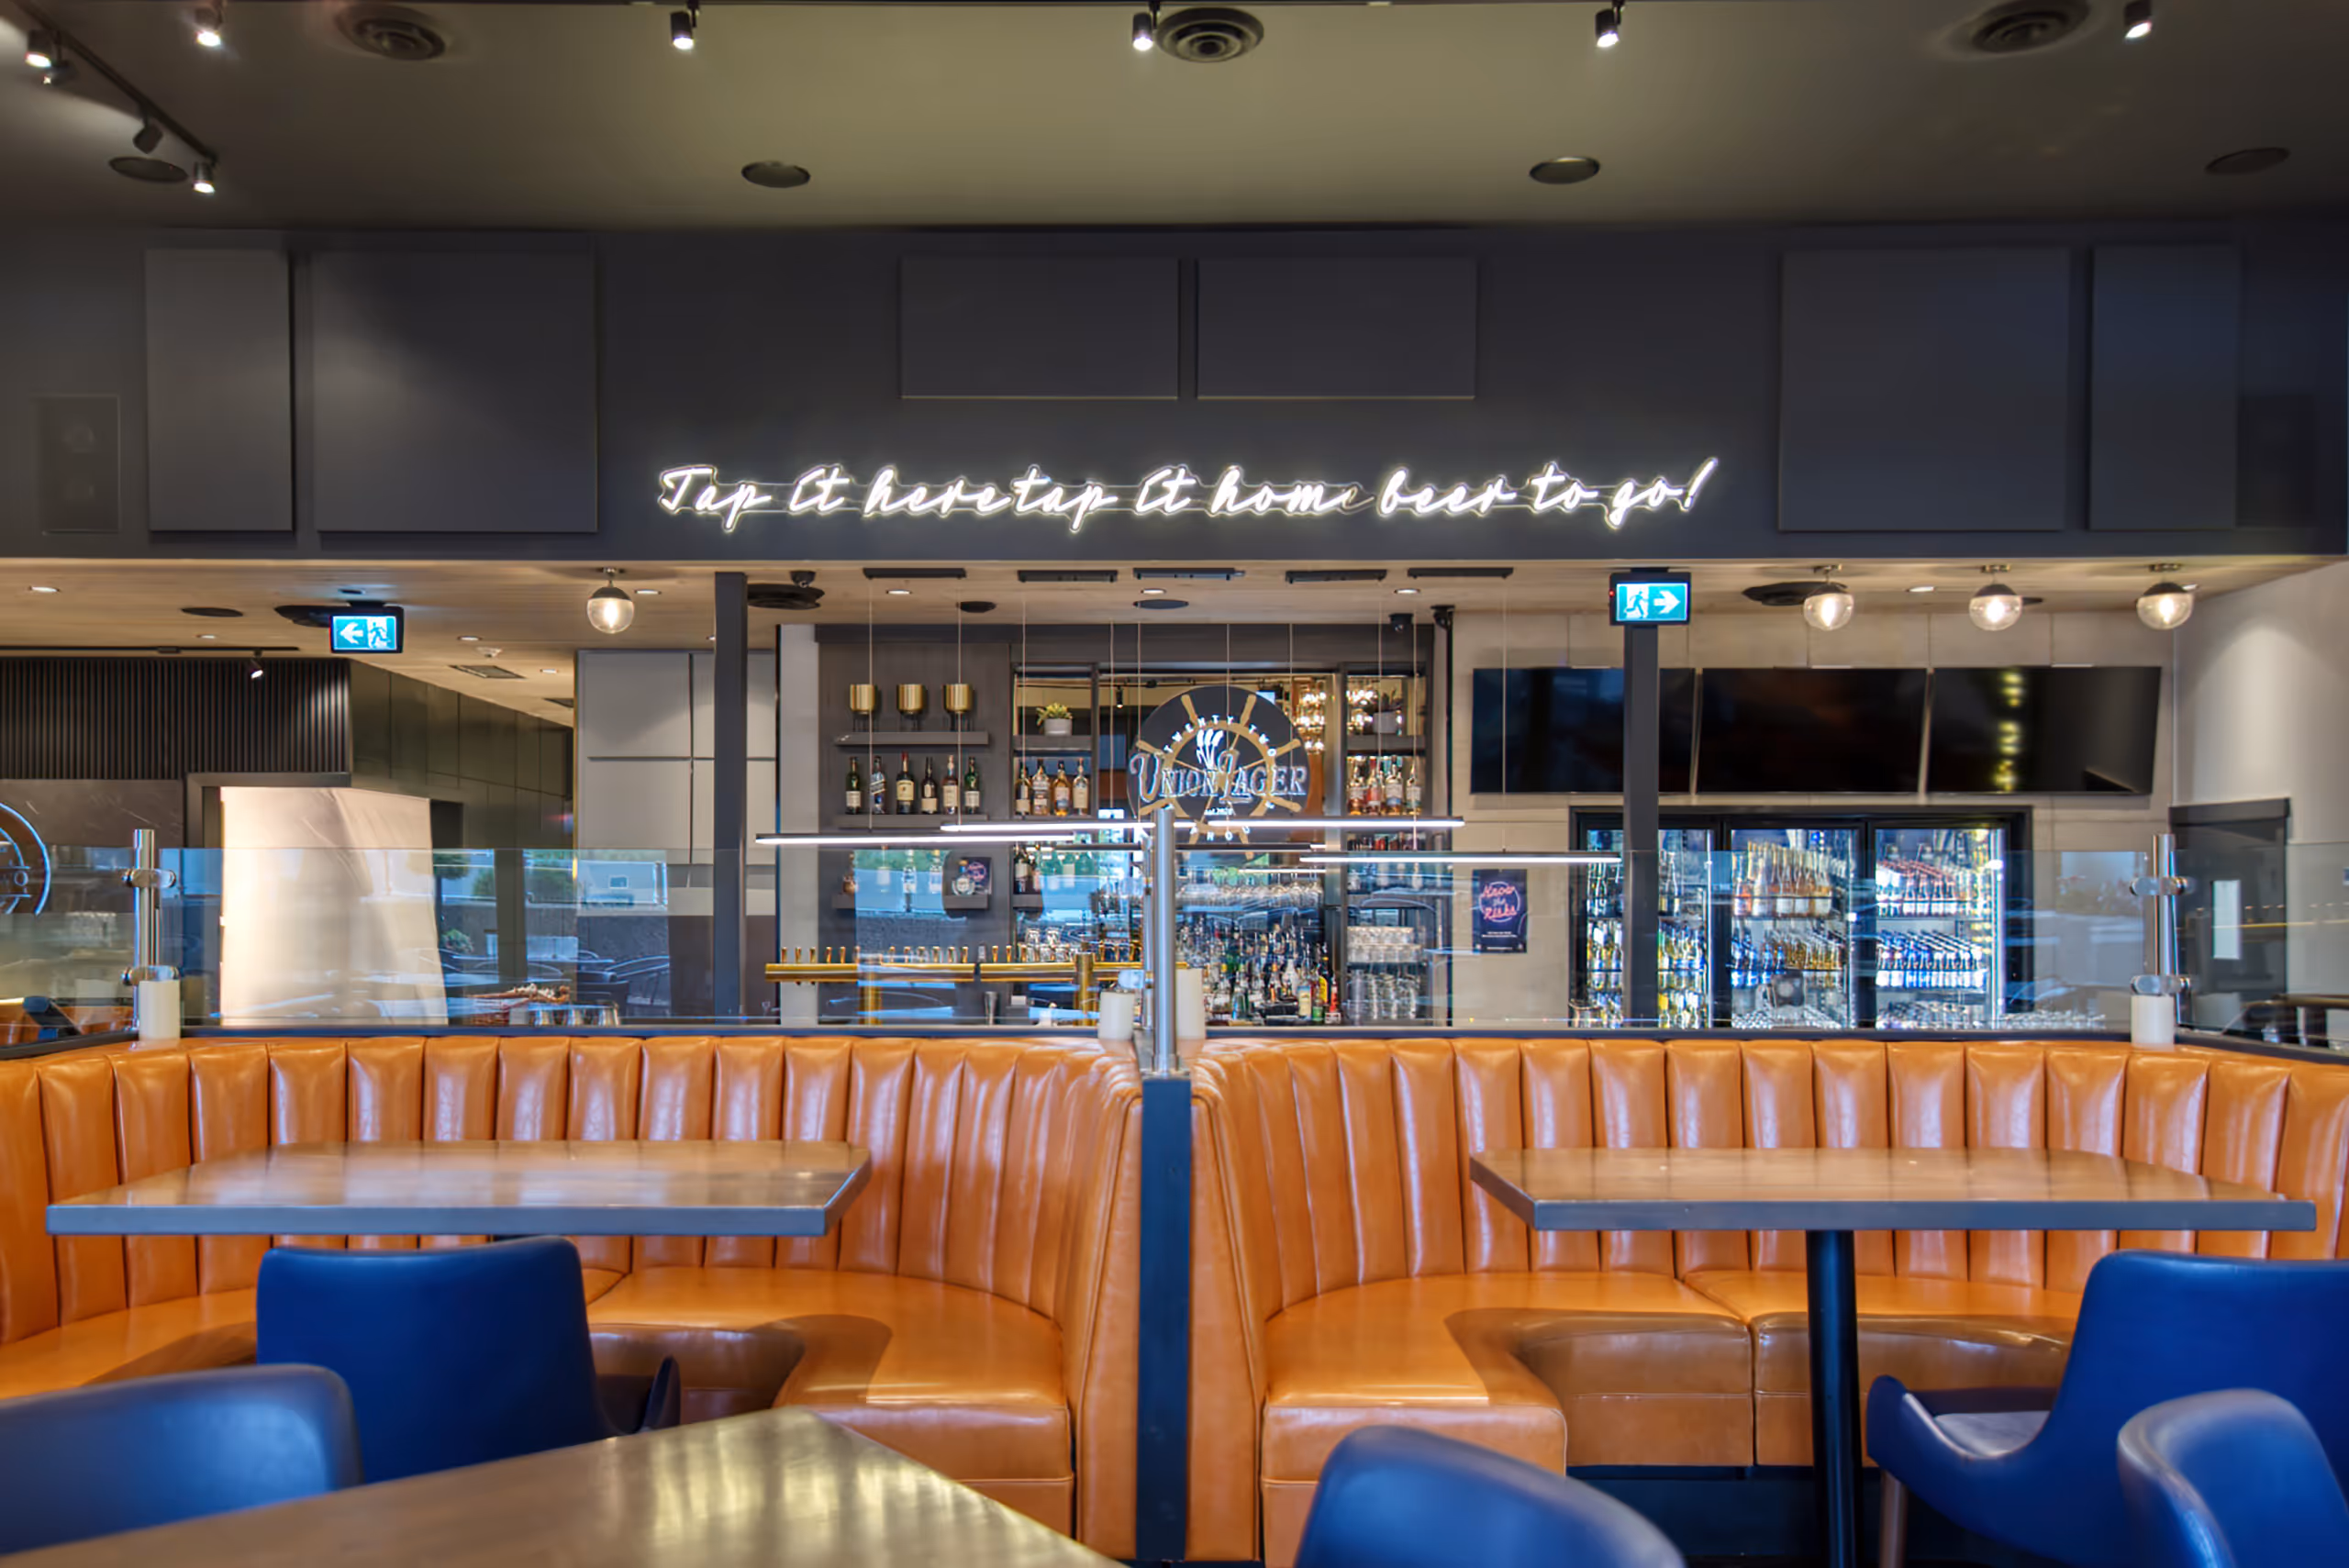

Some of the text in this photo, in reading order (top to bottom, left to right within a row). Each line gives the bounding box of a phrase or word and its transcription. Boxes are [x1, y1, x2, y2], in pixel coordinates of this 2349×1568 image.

[661, 467, 772, 530] Tap
[863, 467, 1011, 516] here
[1013, 467, 1119, 529] tap
[1210, 466, 1375, 516] home
[1381, 469, 1517, 516] beer
[1531, 463, 1599, 509] to
[1609, 459, 1717, 527] go!
[1163, 715, 1276, 757] TWENTY TWO
